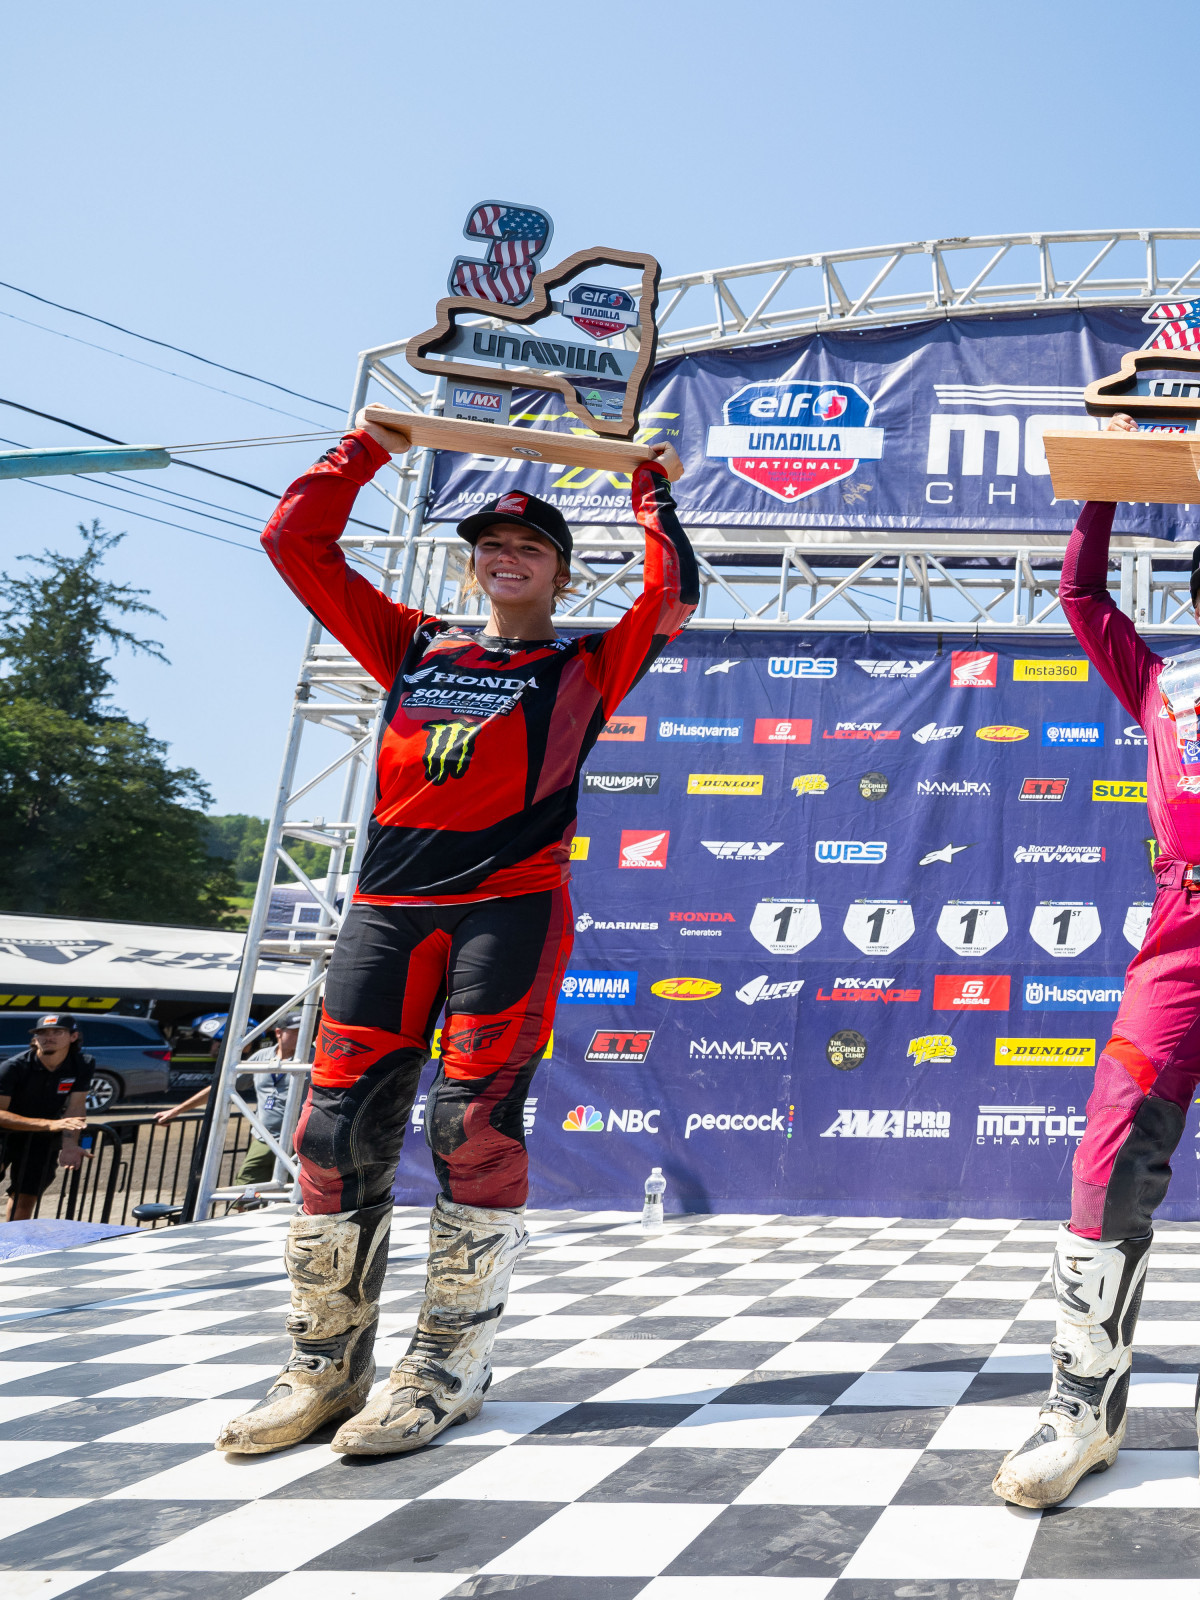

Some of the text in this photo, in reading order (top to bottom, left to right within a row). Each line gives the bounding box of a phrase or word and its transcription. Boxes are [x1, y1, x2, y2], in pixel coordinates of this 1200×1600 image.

[448, 200, 554, 308] 3
[581, 291, 608, 304] elf
[581, 306, 620, 321] UNADILLA
[579, 318, 620, 329] NATIONAL
[473, 332, 623, 377] UNADILLA
[454, 390, 501, 408] WMX
[749, 393, 812, 418] elf
[748, 432, 842, 452] UNADILLA
[745, 460, 842, 471] NATIONAL
[768, 657, 837, 679] WPS
[1024, 666, 1077, 676] Insta360
[431, 671, 539, 690] HONDA
[601, 723, 636, 734] KTM
[673, 725, 740, 739] Husqvarna
[930, 726, 964, 738] UFO
[977, 727, 1029, 740] FMF
[1059, 728, 1099, 738] YAMAHA
[586, 775, 643, 791] TRIUMPH
[793, 775, 826, 785] MOTO
[918, 780, 990, 792] NAMURA
[1023, 780, 1066, 793] ETS
[796, 782, 829, 795] TEES
[1095, 785, 1147, 798] SUZU
[815, 840, 888, 864] WPS
[1029, 844, 1054, 852] ROCKY
[669, 912, 736, 922] HONDA
[595, 921, 658, 930] MARINES
[680, 928, 722, 936] Generators
[578, 979, 630, 993] YAMAHA
[652, 980, 721, 998] FMF
[760, 980, 804, 994] UFO
[816, 989, 921, 1004] LEGENDS
[591, 1032, 651, 1052] ETS
[690, 1038, 787, 1056] NAMURA
[910, 1035, 952, 1049] MOTO
[914, 1044, 956, 1065] TEES
[1014, 1046, 1091, 1055] DUNLOP
[606, 1108, 660, 1133] NBC
[684, 1108, 785, 1139] peacock
[820, 1109, 905, 1138] AMA
[906, 1111, 950, 1128] PRO
[977, 1115, 1088, 1136] MOTOC
[906, 1128, 949, 1138] RACING
